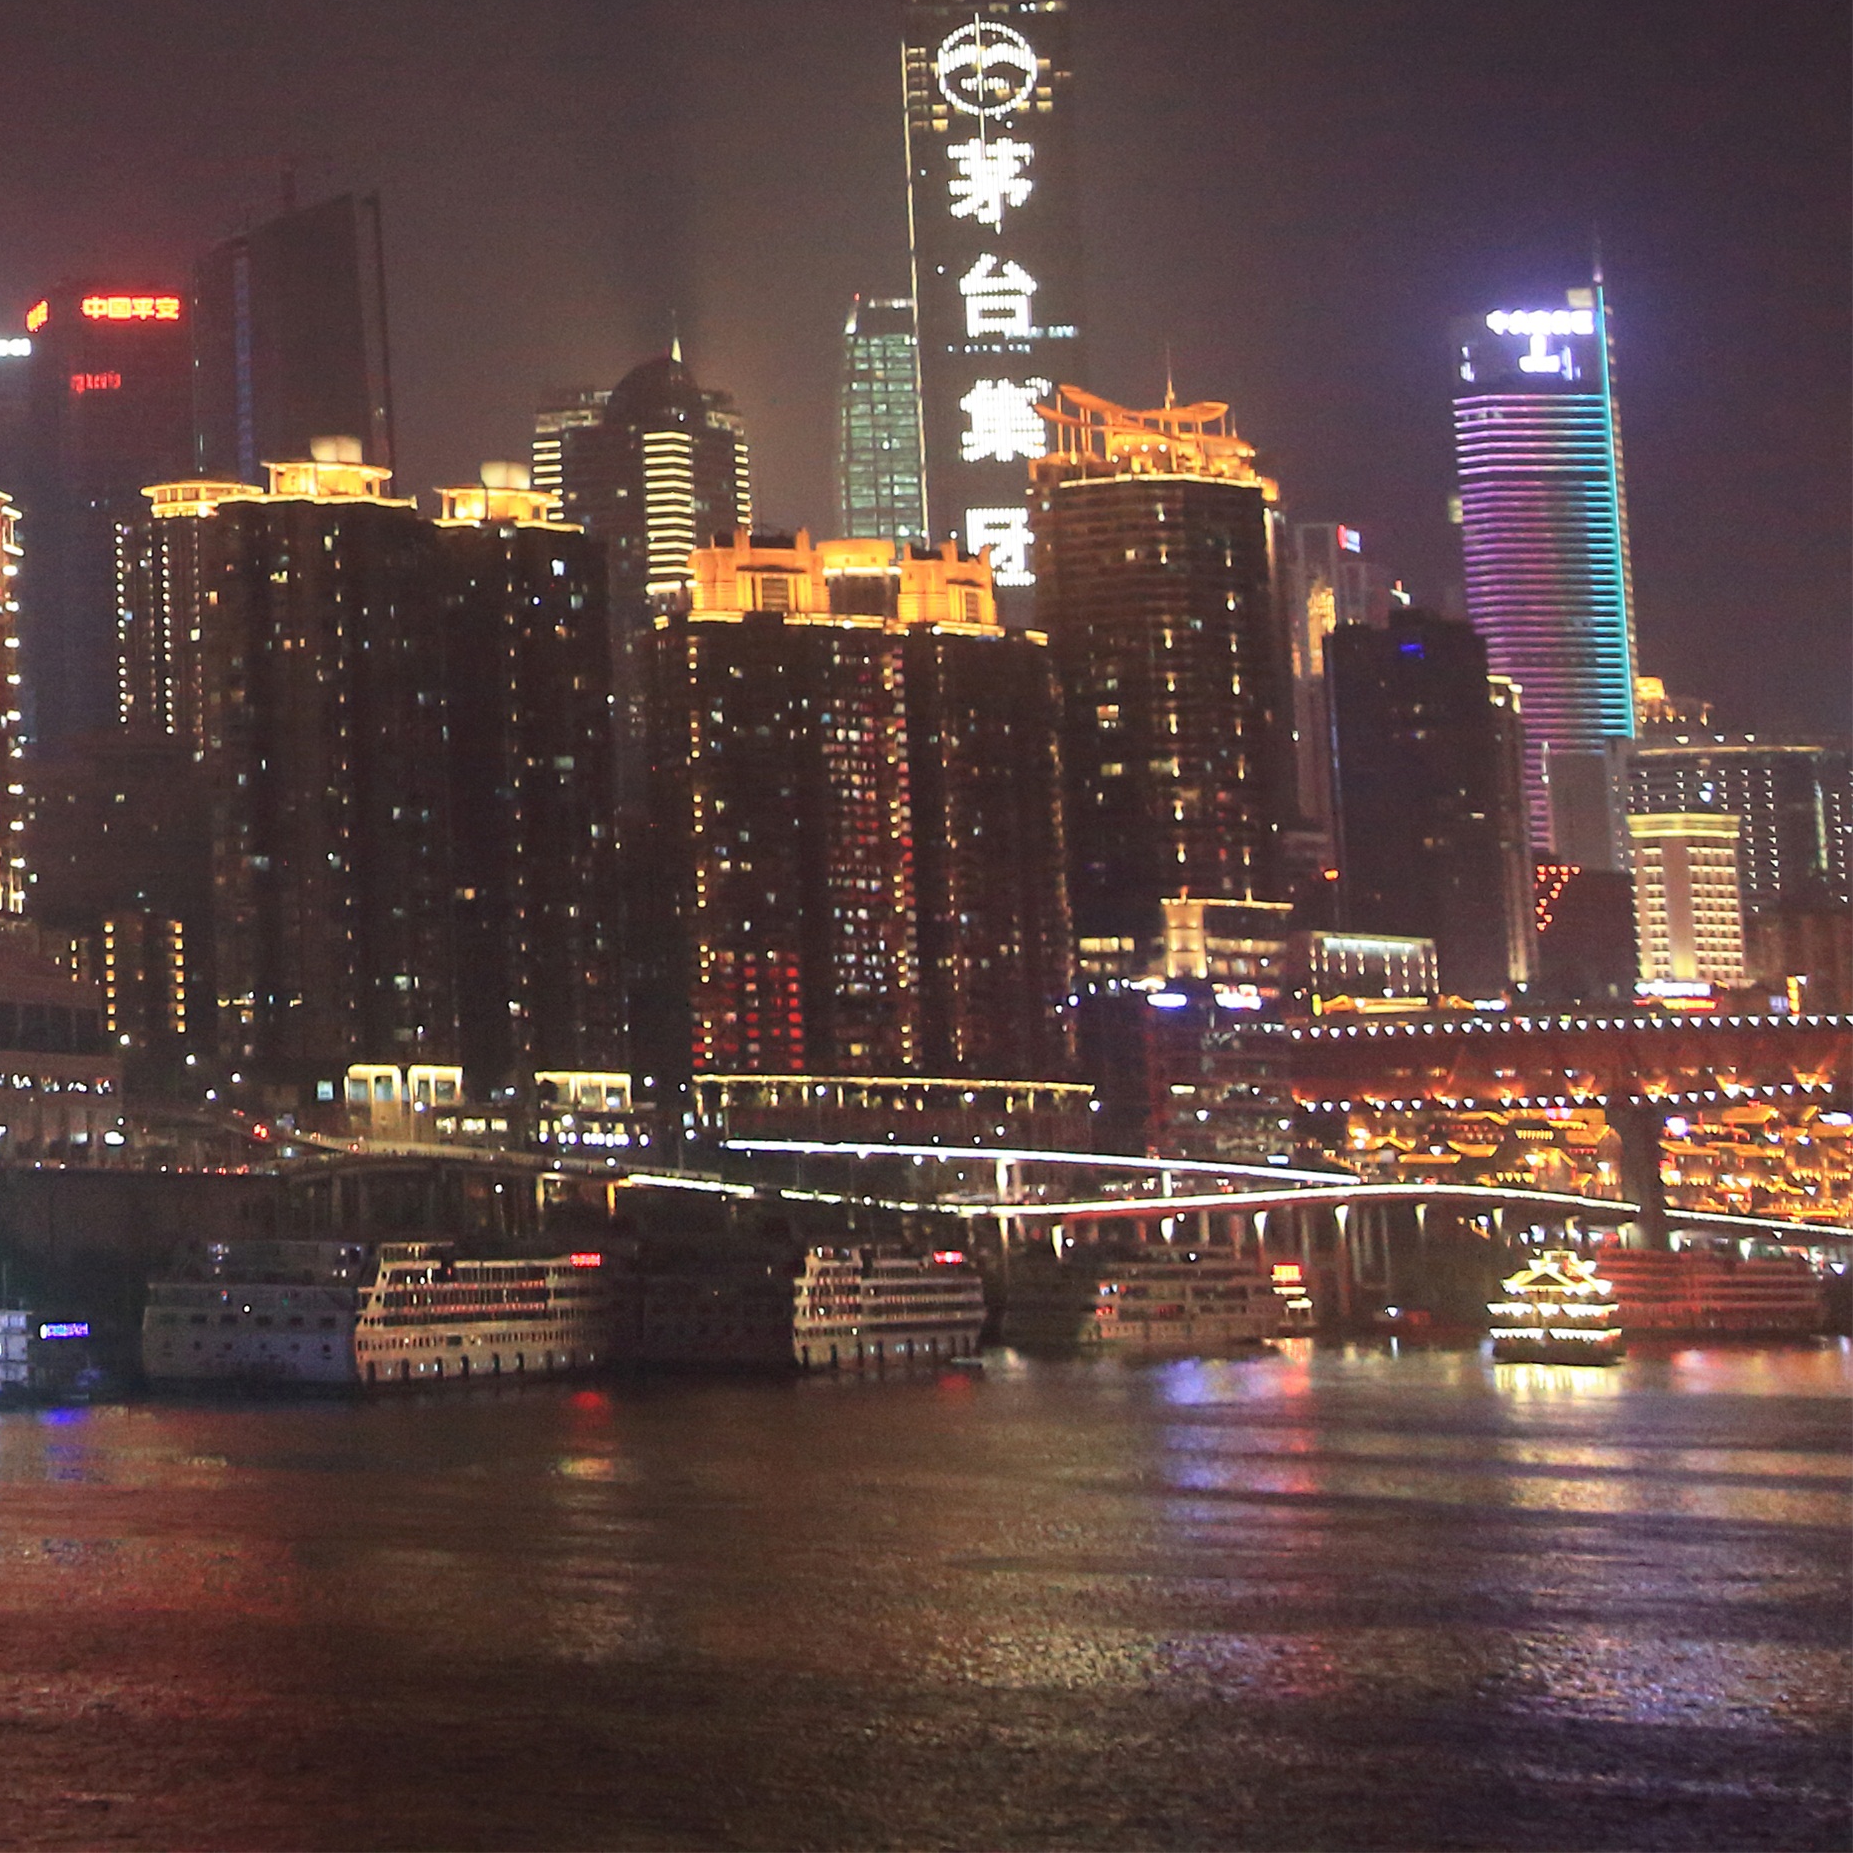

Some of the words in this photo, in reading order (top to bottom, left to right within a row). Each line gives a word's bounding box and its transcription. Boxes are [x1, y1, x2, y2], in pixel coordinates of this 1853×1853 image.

[81, 296, 180, 320] 中国平安
[947, 137, 1048, 587] 茅台集团
